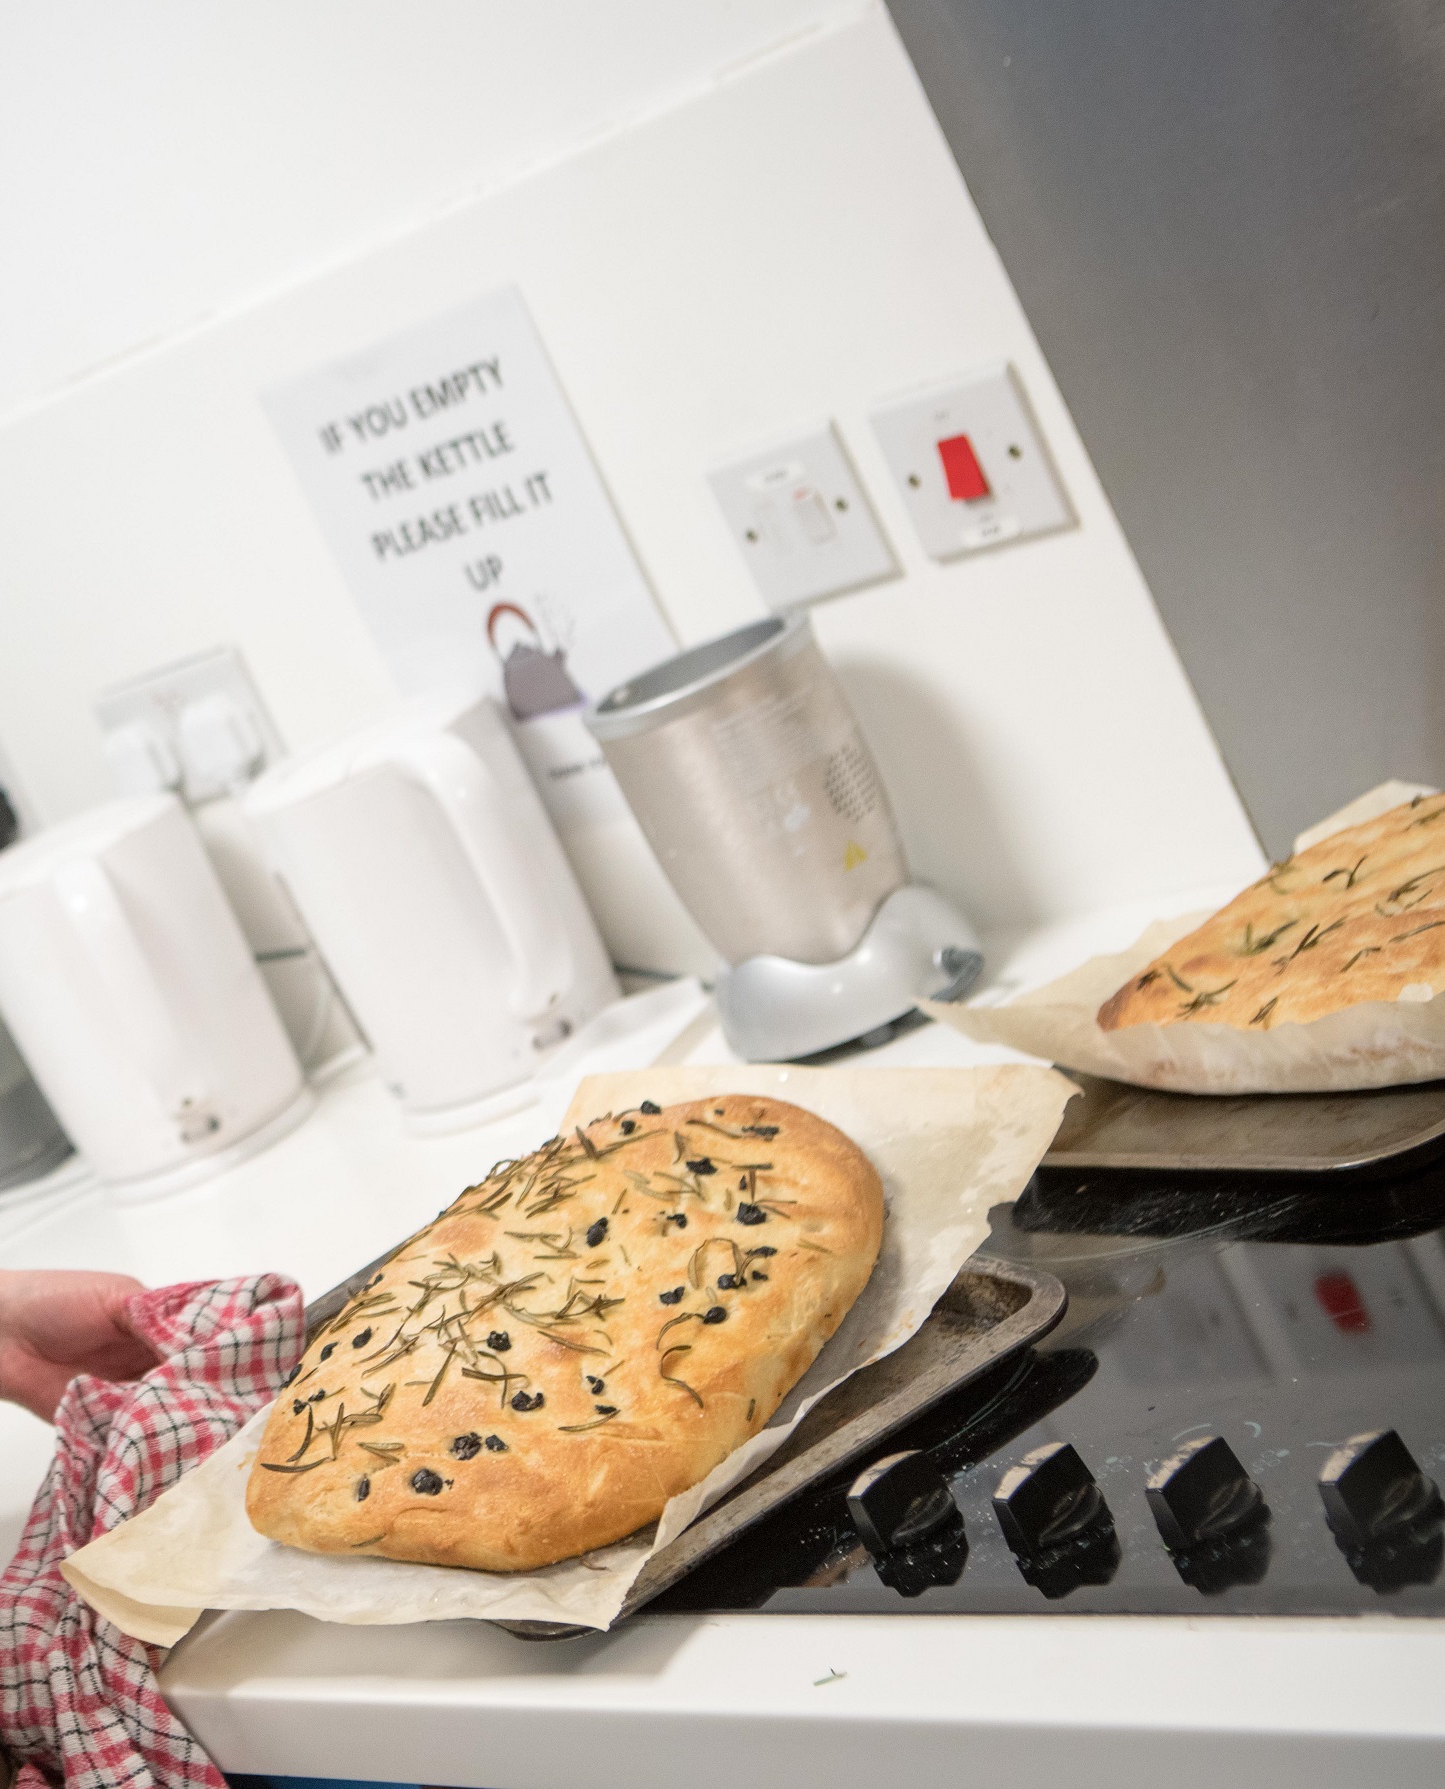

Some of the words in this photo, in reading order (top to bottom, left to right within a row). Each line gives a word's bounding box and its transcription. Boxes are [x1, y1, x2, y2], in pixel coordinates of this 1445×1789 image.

[318, 422, 343, 457] IF
[346, 397, 408, 442] YOU
[410, 356, 503, 420] EMPTY
[360, 458, 417, 501] THE
[418, 422, 514, 479] KETTLE
[370, 502, 468, 563] PLEASE
[469, 483, 526, 528] FILL
[525, 471, 553, 507] IT
[464, 553, 504, 592] UP
